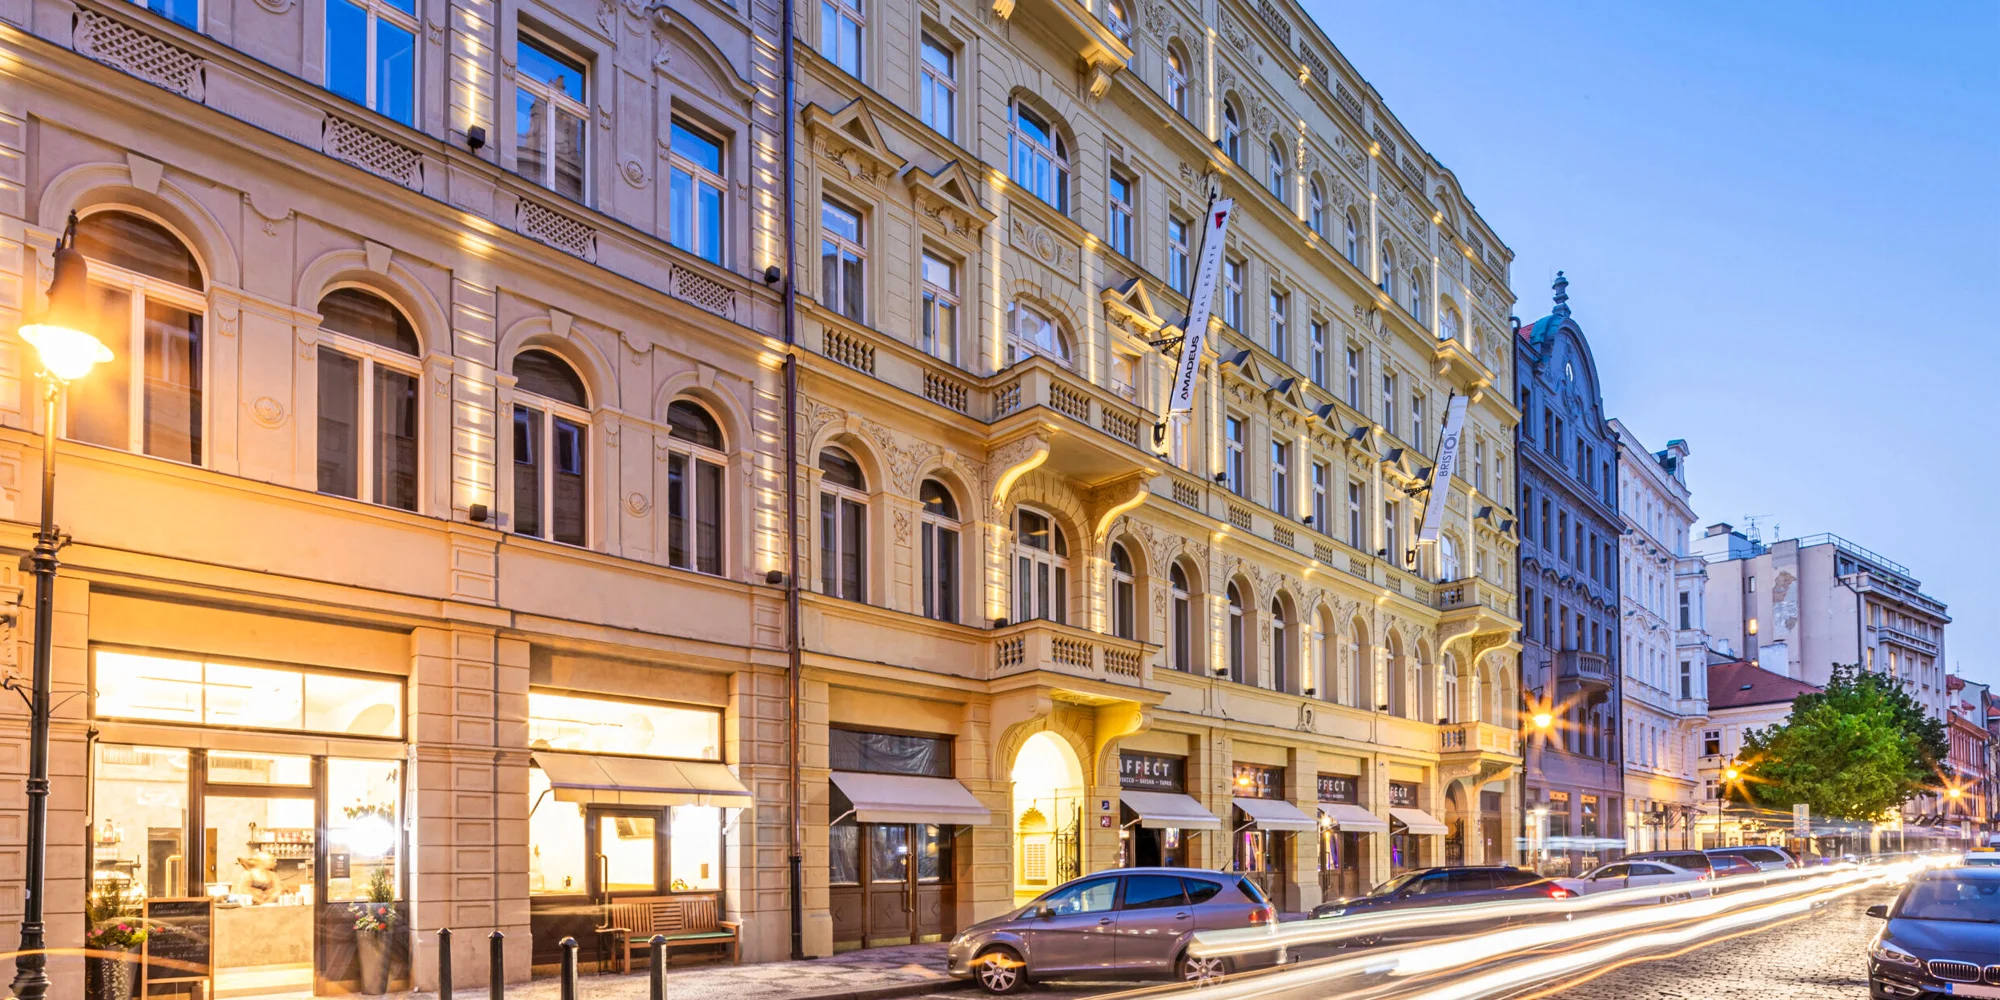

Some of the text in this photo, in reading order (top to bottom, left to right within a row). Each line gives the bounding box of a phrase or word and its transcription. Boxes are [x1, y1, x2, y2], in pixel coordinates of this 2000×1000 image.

[1181, 245, 1217, 400] AMADEUS REAL ESTATE
[1439, 431, 1457, 476] BRISTOL
